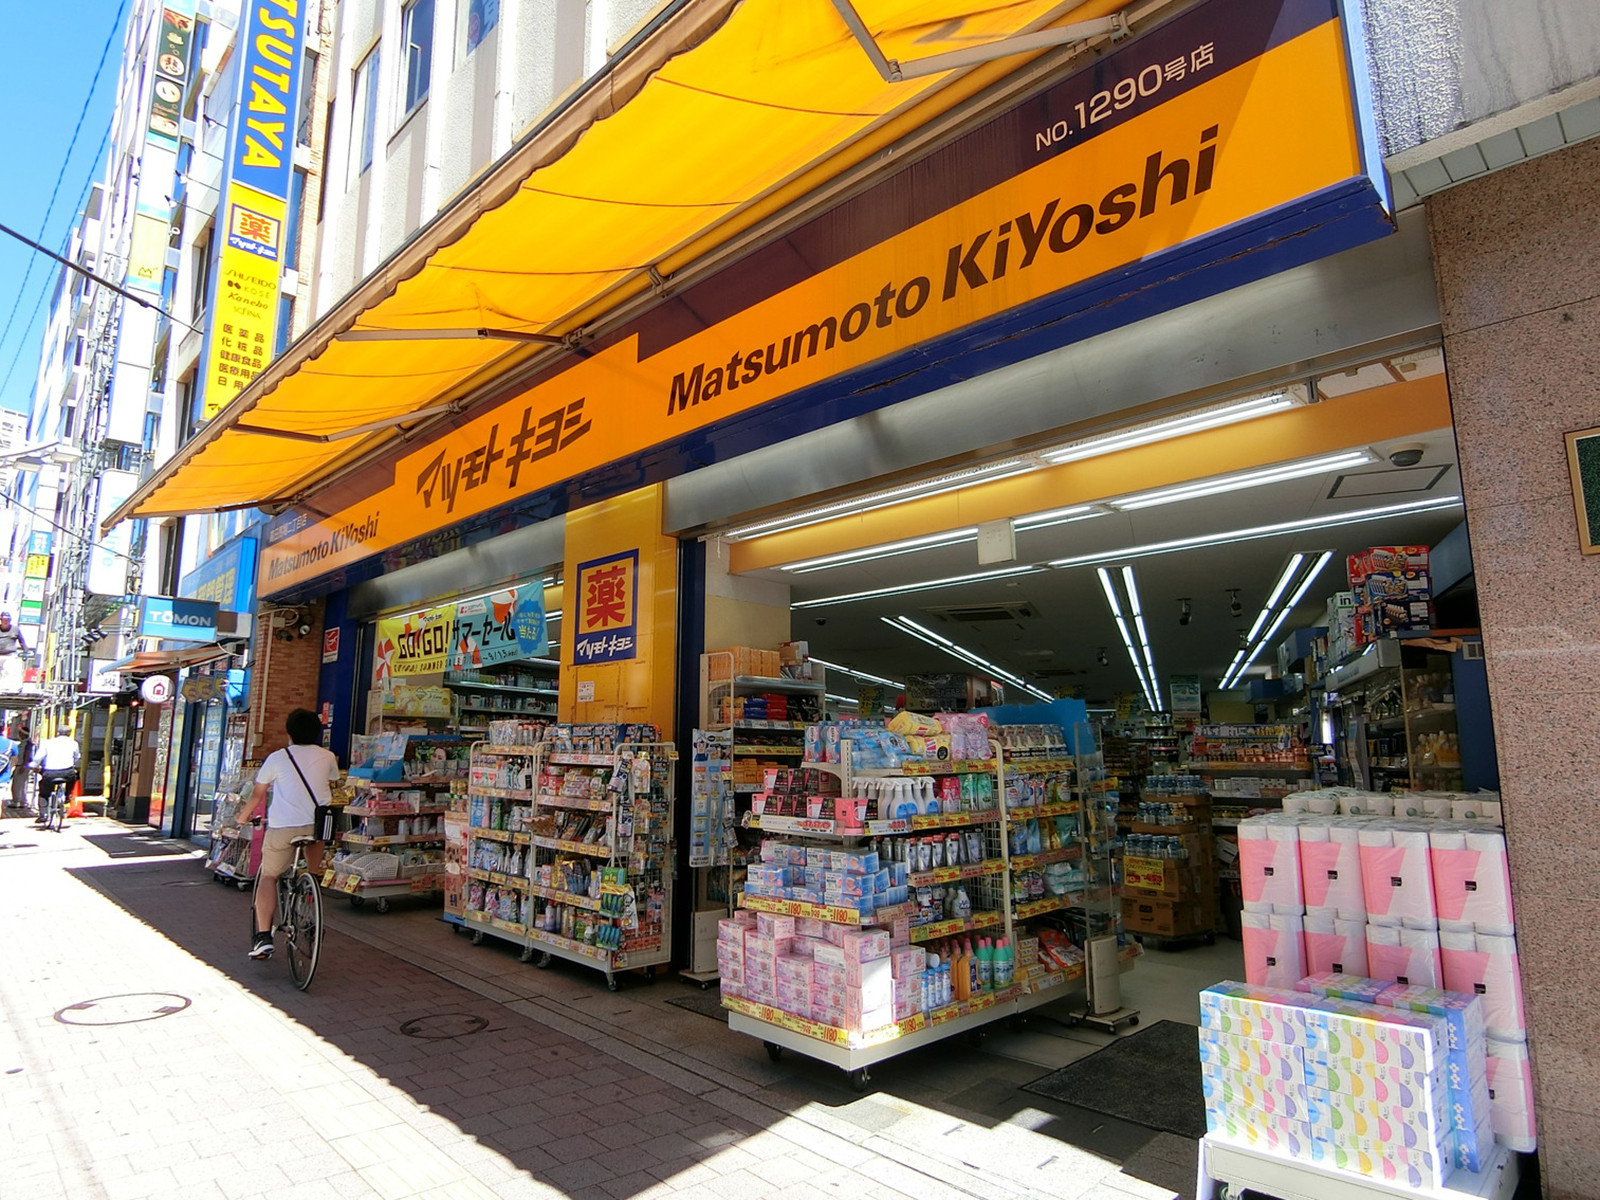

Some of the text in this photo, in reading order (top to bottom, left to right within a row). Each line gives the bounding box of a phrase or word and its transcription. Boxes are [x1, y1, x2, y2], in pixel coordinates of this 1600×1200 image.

[242, 0, 298, 168] TSUTAYA
[240, 212, 271, 244] 薬
[226, 269, 277, 290] SHISEIDO
[667, 124, 1219, 416] Matsumoto KiYoshi
[228, 292, 268, 310] Kanebo
[223, 323, 264, 343] 医薬品
[222, 336, 263, 356] 化粧品
[220, 350, 262, 369] 健康食品
[416, 397, 592, 513] マツモトキヨシ
[268, 541, 329, 580] Matsumoto
[330, 511, 380, 555] KiYoshi
[586, 565, 627, 628] 薬
[1339, 595, 1352, 605] in
[452, 611, 516, 650] サマーセール
[576, 634, 633, 660] マツモトキヨシ
[788, 902, 801, 916] 1180
[833, 908, 848, 922] 1180
[761, 1006, 774, 1021] 1180
[824, 1026, 837, 1042] 1180
